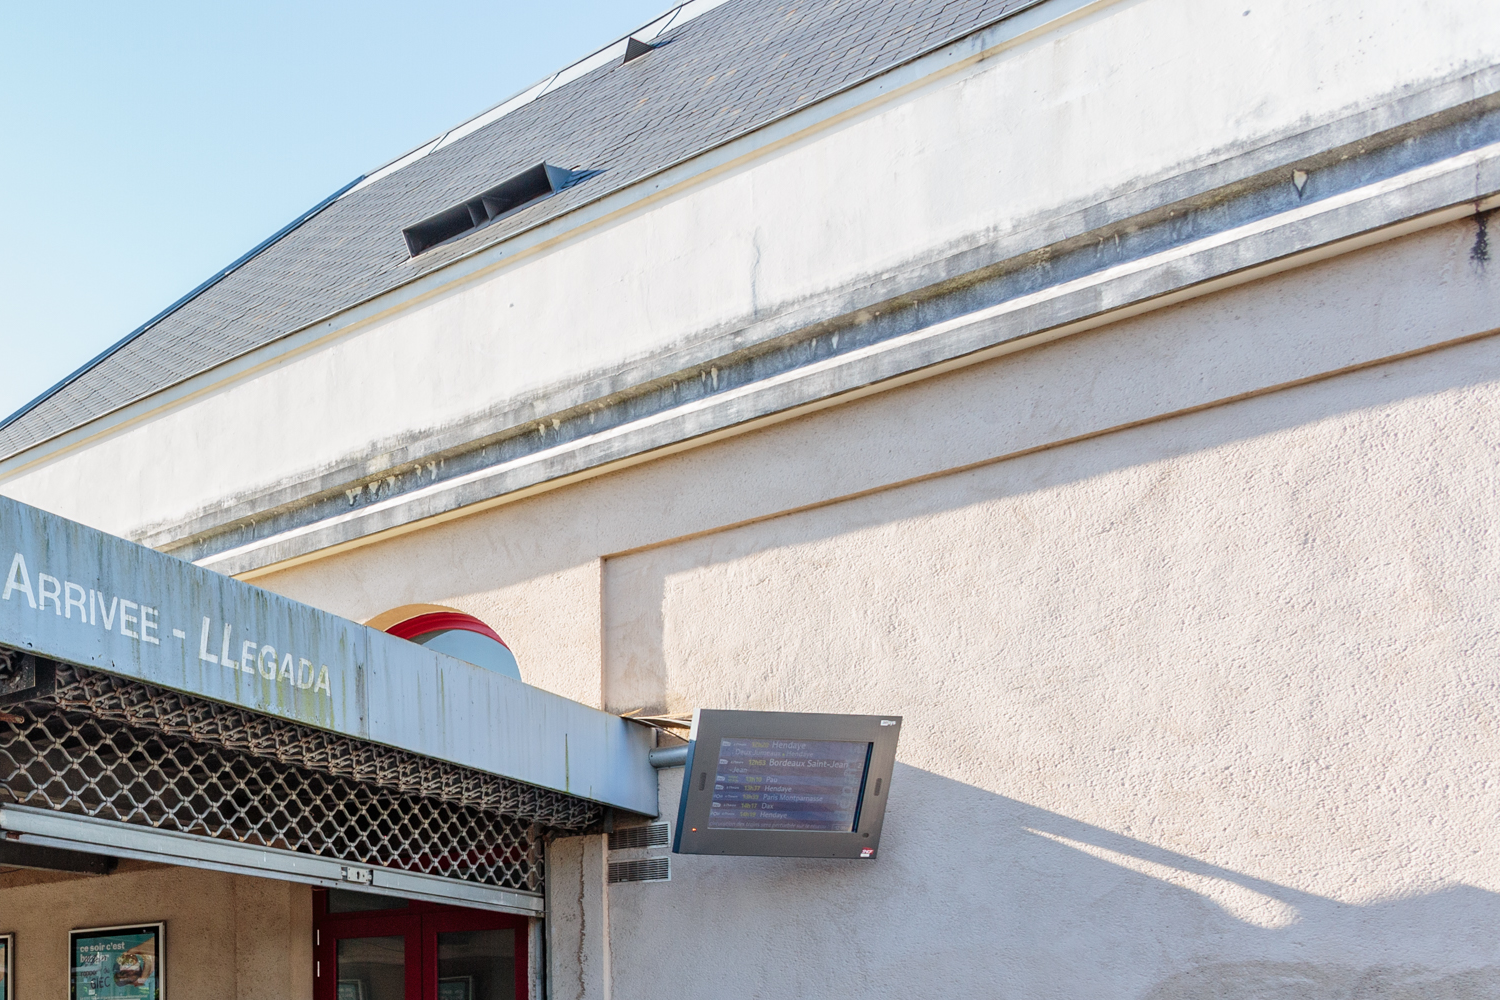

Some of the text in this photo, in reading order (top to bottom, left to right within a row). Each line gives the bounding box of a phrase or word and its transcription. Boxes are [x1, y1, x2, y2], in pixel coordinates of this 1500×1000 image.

[771, 740, 806, 750] Hendaye
[769, 758, 805, 767] Bordeaux
[806, 760, 848, 768] Saint-Jean
[764, 785, 792, 794] Hendaye
[780, 794, 823, 802] Montparnasse
[90, 943, 105, 951] soir
[106, 942, 125, 950] c'est
[90, 976, 110, 990] GIEC
